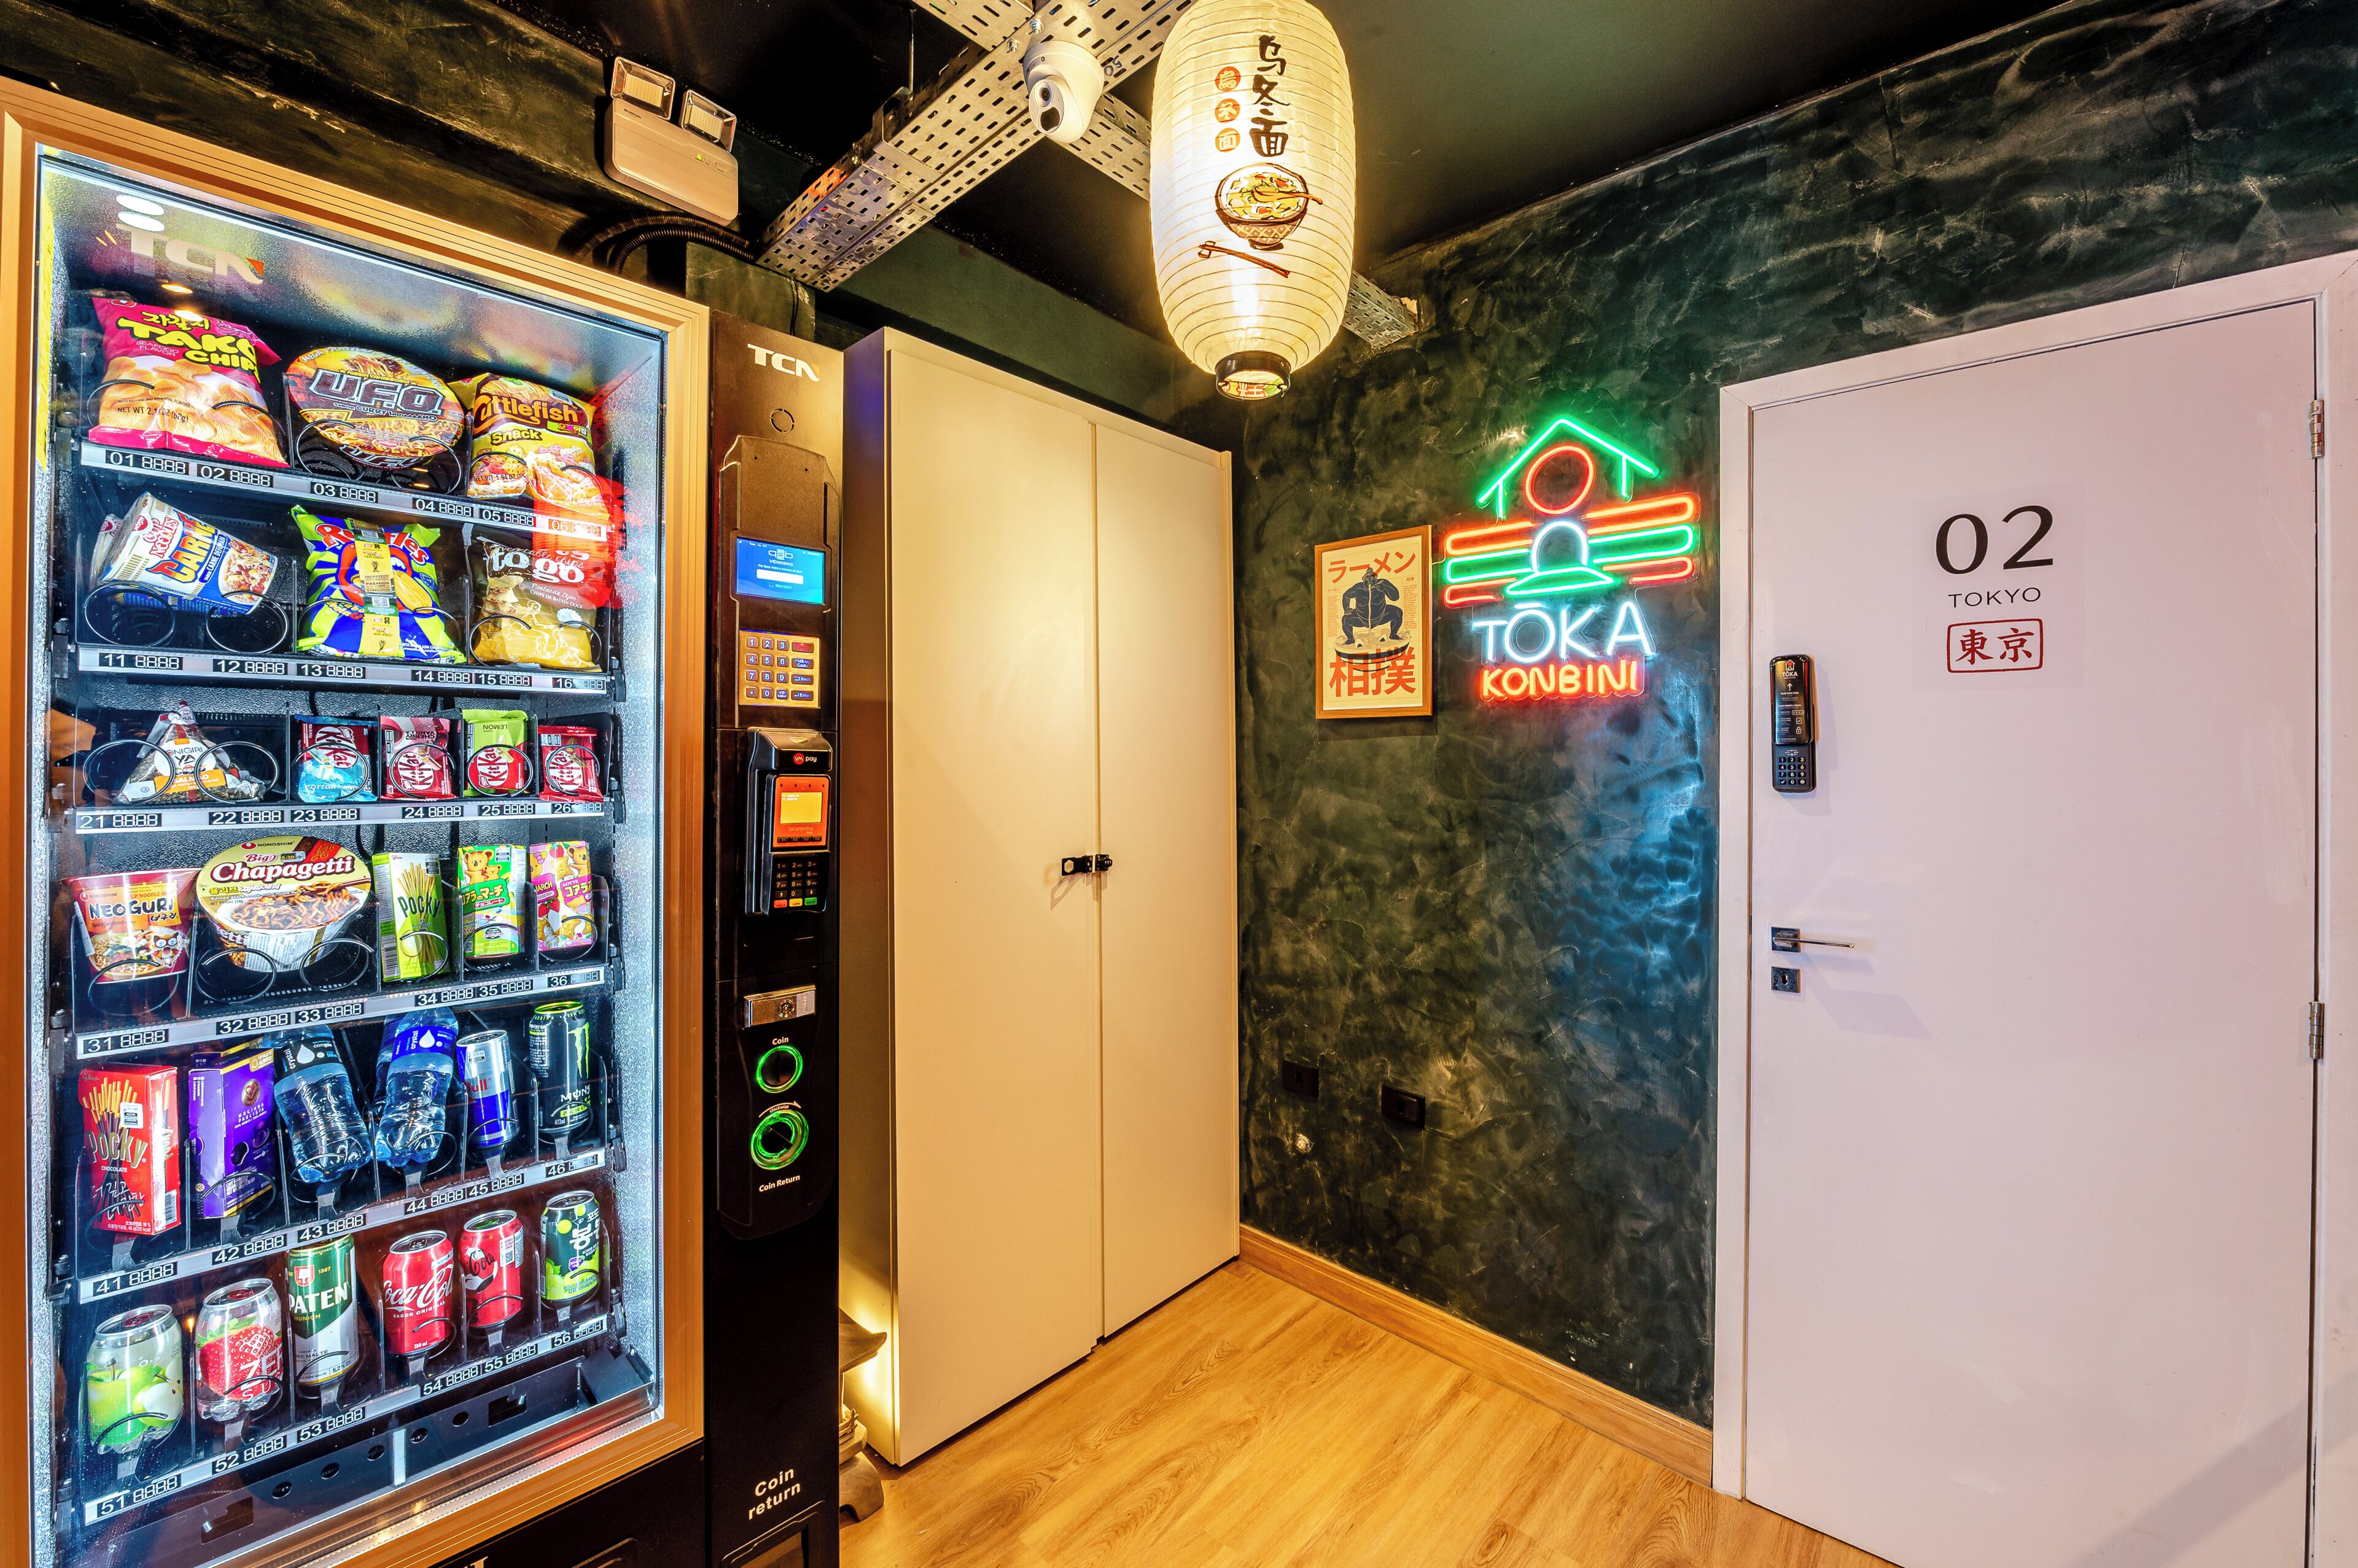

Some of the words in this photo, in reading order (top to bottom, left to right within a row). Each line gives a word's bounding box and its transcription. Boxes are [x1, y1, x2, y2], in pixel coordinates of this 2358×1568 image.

[117, 223, 263, 284] TCN
[117, 317, 257, 366] TAKO
[136, 341, 179, 354] SEAFOOD
[139, 345, 176, 357] FLAVOR
[302, 350, 323, 362] MEGA
[747, 343, 820, 382] TCN
[356, 405, 386, 416] CURRY
[473, 394, 578, 432] Cuttlefish
[491, 429, 543, 445] Snack
[110, 452, 133, 467] 01
[201, 466, 225, 481] 02
[314, 483, 335, 496] 03
[416, 500, 435, 512] 04
[483, 510, 500, 521] 05
[142, 518, 162, 543] CUP
[551, 521, 568, 532] 06
[150, 517, 179, 558] NOODLES
[1936, 505, 2053, 575] 02
[146, 510, 217, 583] CARNE
[206, 551, 219, 572] CARNE
[213, 535, 228, 553] DEFUMADA
[491, 548, 530, 571] to
[533, 559, 584, 583] go
[556, 555, 584, 569] chips
[1328, 551, 1416, 583] ラーメン
[1948, 588, 2041, 608] TOKYO
[1955, 627, 2034, 665] 東京
[104, 654, 124, 667] 11
[217, 660, 240, 673] 12
[300, 664, 322, 677] 13
[415, 670, 434, 682] 14
[1329, 646, 1416, 697] 相撲
[478, 674, 496, 685] 15
[556, 678, 572, 688] 16
[1482, 659, 1638, 697] KONBINI
[174, 755, 196, 766] YA
[405, 807, 424, 818] 24
[481, 805, 500, 816] 25
[554, 804, 571, 813] 26
[80, 815, 103, 828] 21
[212, 812, 236, 825] 22
[294, 810, 316, 822] 23
[212, 857, 355, 882] Chapagetti
[209, 887, 238, 895] 올리브
[88, 897, 173, 920] NEOGURI
[550, 976, 567, 987] 36
[479, 985, 497, 996] 35
[418, 993, 437, 1006] 34
[298, 1009, 321, 1022] 33
[220, 1020, 244, 1033] 32
[88, 1038, 112, 1052] 31
[772, 1036, 789, 1045] Coin
[284, 1049, 296, 1069] crystal
[239, 1107, 264, 1123] PAULISTA
[769, 1104, 789, 1113] clockwise
[548, 1164, 565, 1175] 46
[759, 1182, 775, 1192] Coin
[777, 1175, 800, 1187] Return
[469, 1186, 488, 1197] 45
[407, 1201, 427, 1213] 44
[299, 1225, 323, 1240] 43
[214, 1247, 239, 1263] 42
[96, 1278, 122, 1294] 41
[416, 1300, 446, 1316] ORIGINAL
[554, 1334, 571, 1346] 56
[306, 1349, 328, 1358] MALTE
[485, 1357, 502, 1372] 55
[424, 1380, 442, 1395] 54
[300, 1426, 322, 1440] 53
[215, 1456, 239, 1472] 52
[755, 1469, 794, 1496] Coin
[101, 1497, 126, 1515] 51
[749, 1483, 801, 1520] return
